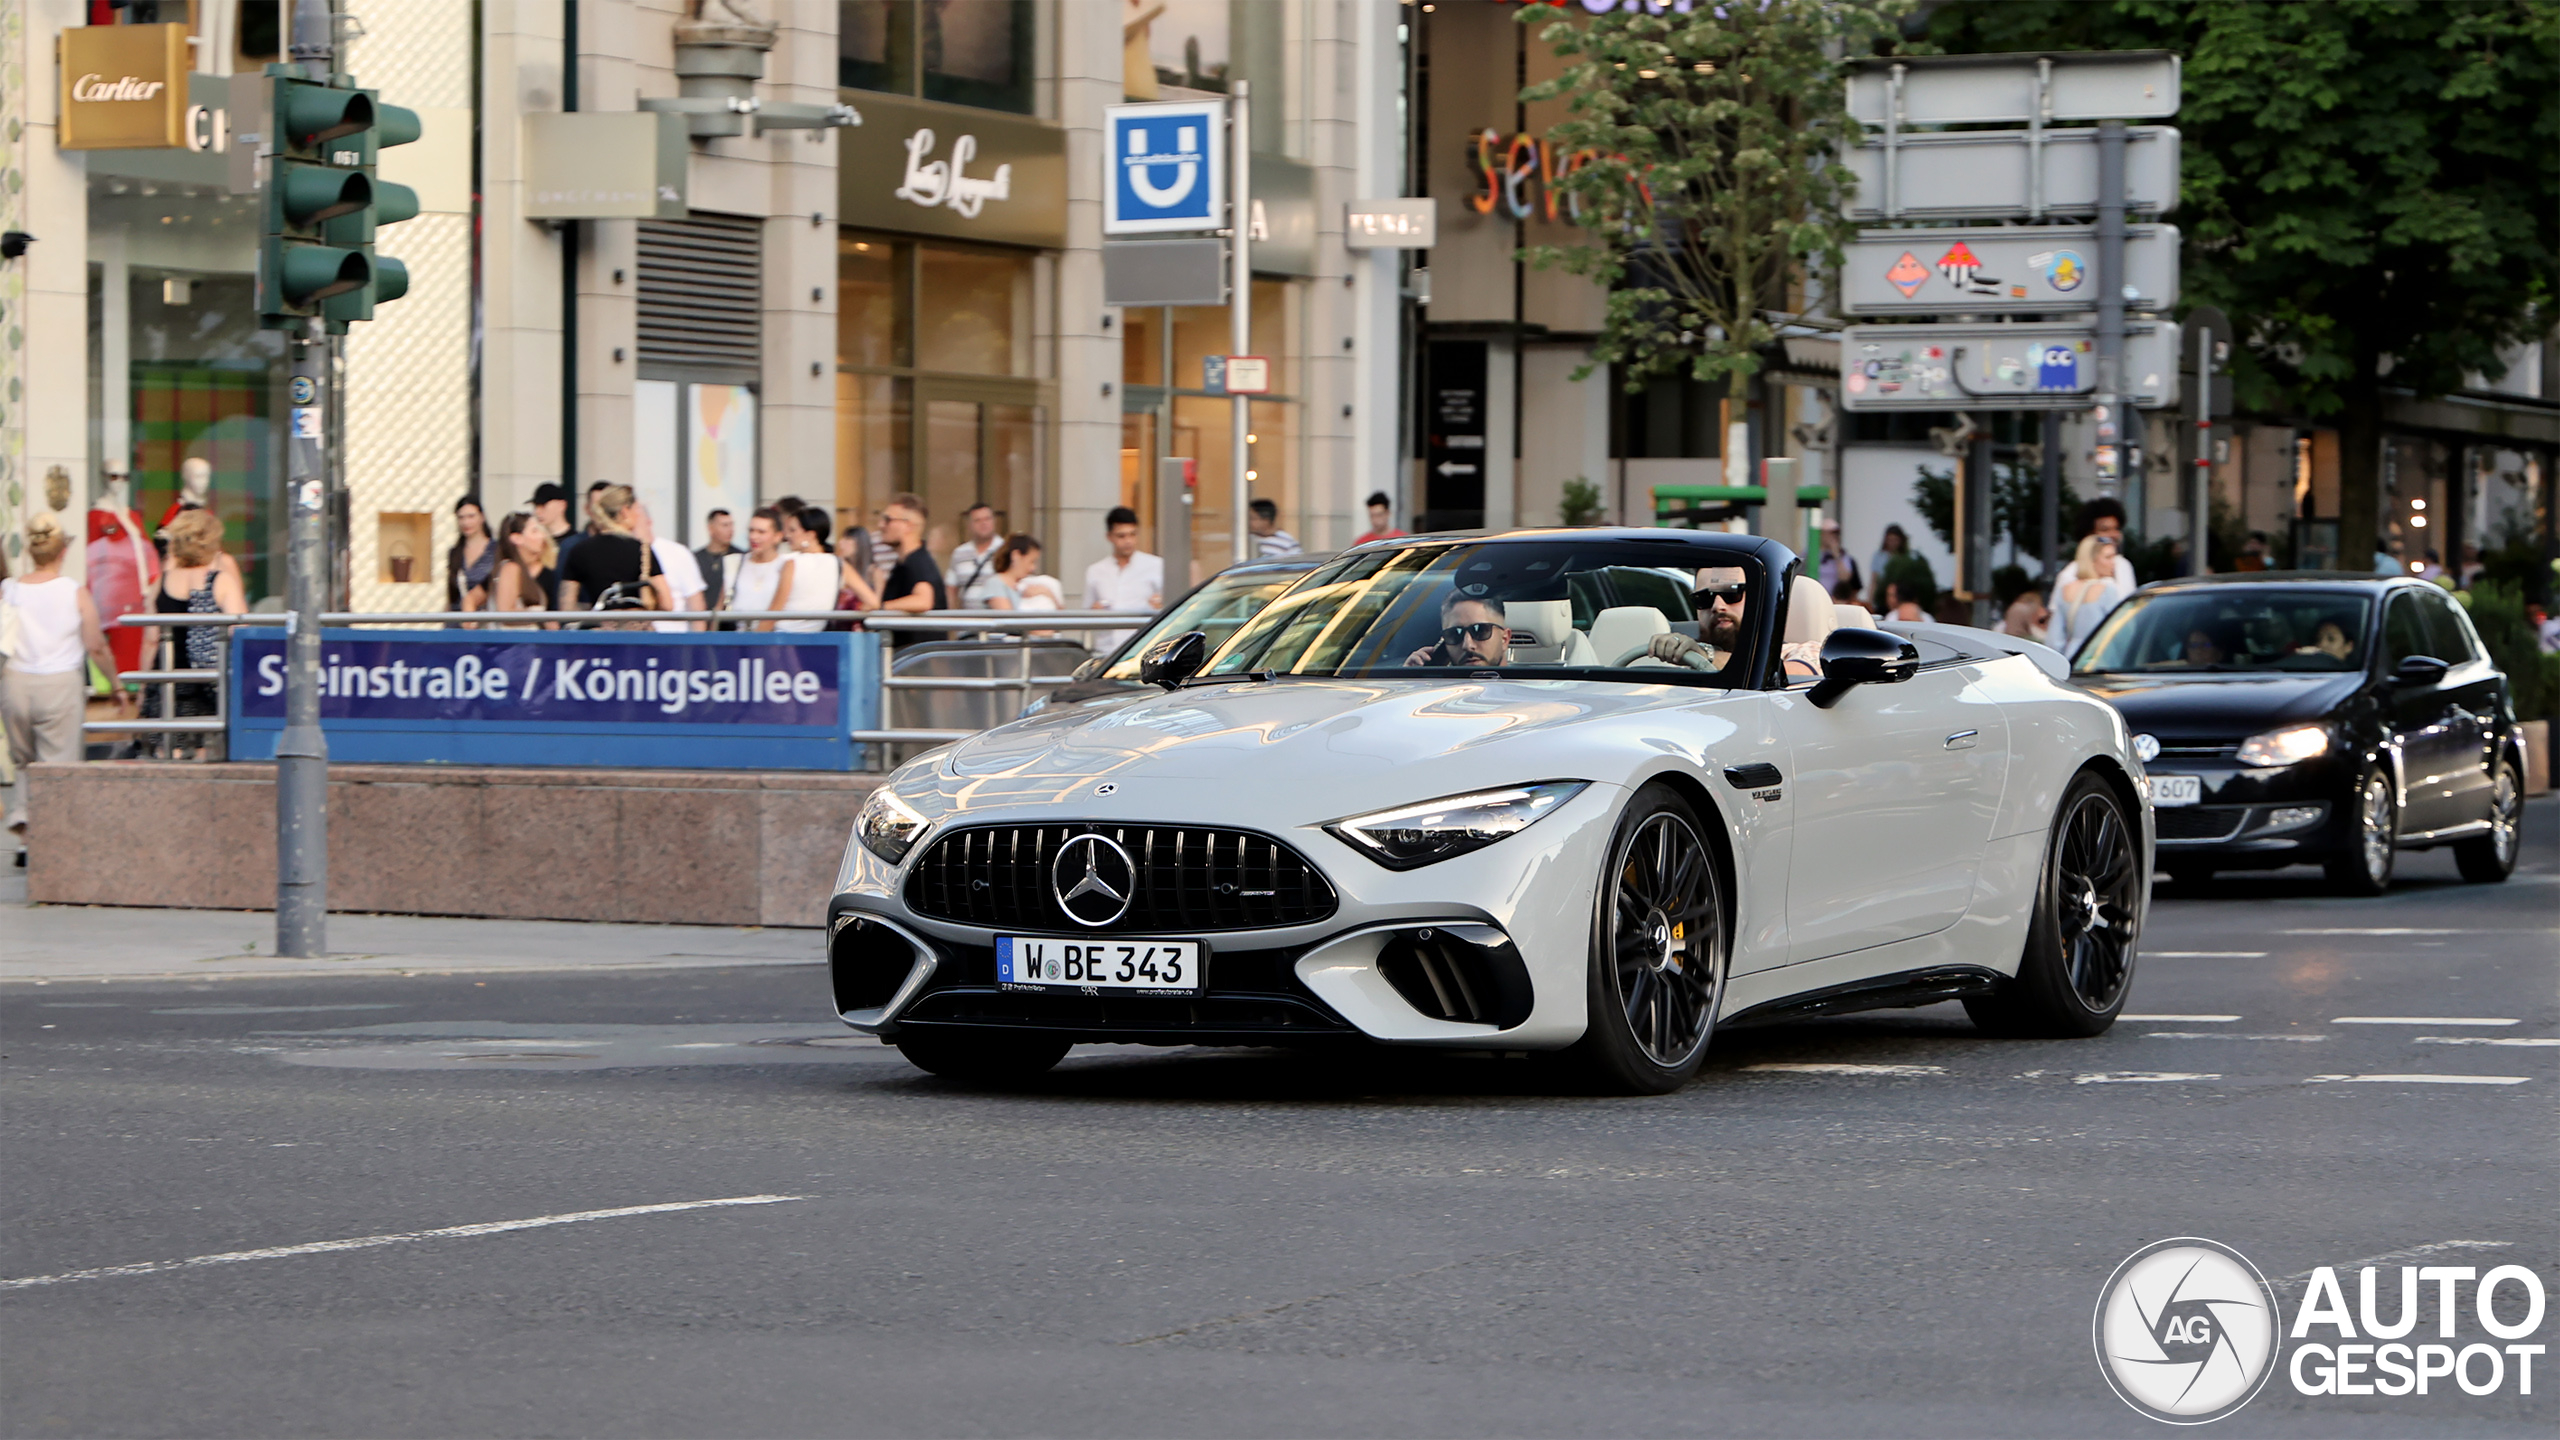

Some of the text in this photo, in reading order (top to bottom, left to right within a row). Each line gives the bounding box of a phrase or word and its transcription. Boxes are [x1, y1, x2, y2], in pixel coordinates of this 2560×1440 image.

[73, 73, 165, 102] Cartier
[257, 653, 822, 714] Sinstraße / Königsallee
[2160, 779, 2196, 798] 607
[1001, 943, 1183, 984] D W BE 343
